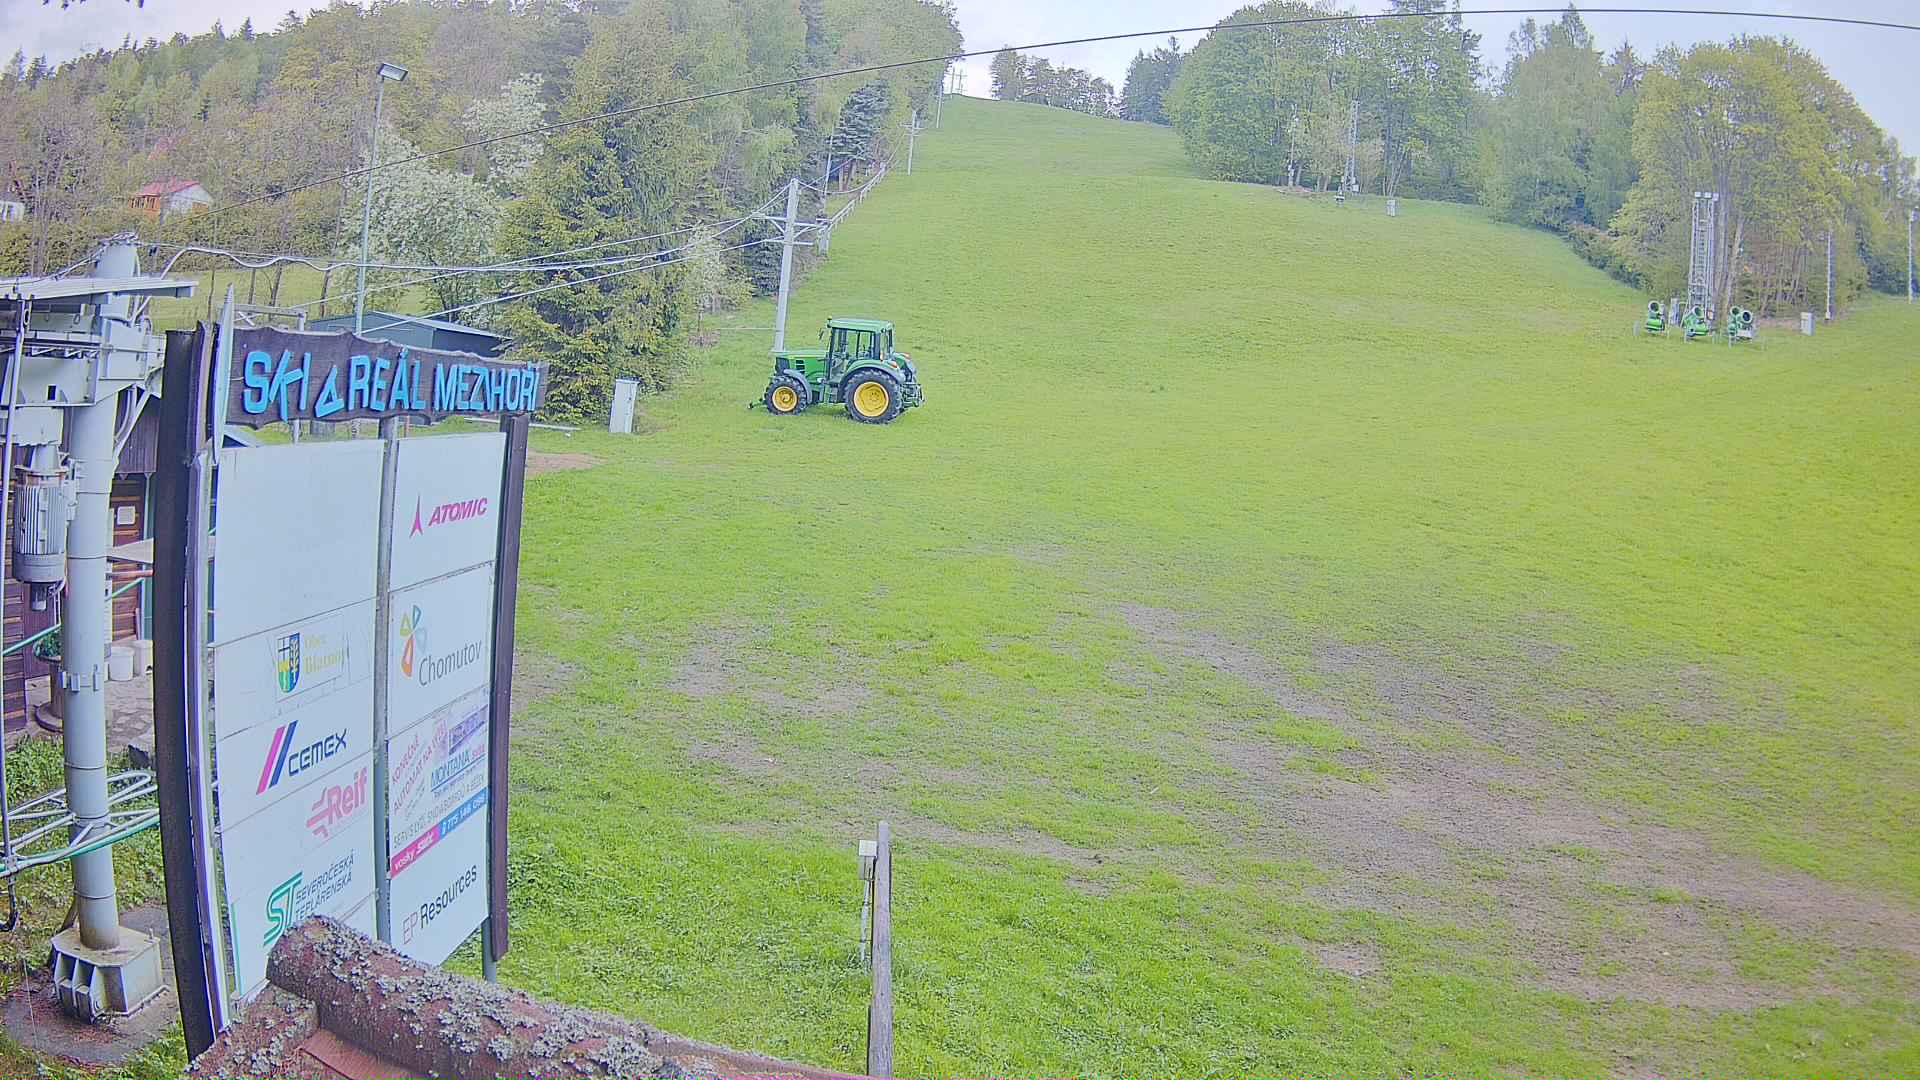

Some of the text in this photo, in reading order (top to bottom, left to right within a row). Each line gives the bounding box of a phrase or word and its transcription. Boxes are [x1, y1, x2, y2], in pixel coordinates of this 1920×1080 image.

[243, 348, 311, 423] SKI
[428, 497, 488, 528] ATOMIC
[418, 639, 482, 687] Chomutov
[288, 727, 347, 777] CEMEX
[430, 750, 471, 790] MONTANA
[320, 766, 368, 828] Reif
[294, 868, 353, 921] TEPLÁRENSKÁ
[295, 848, 354, 905] SEVEROČESKÁ
[402, 864, 477, 945] EP Resources
